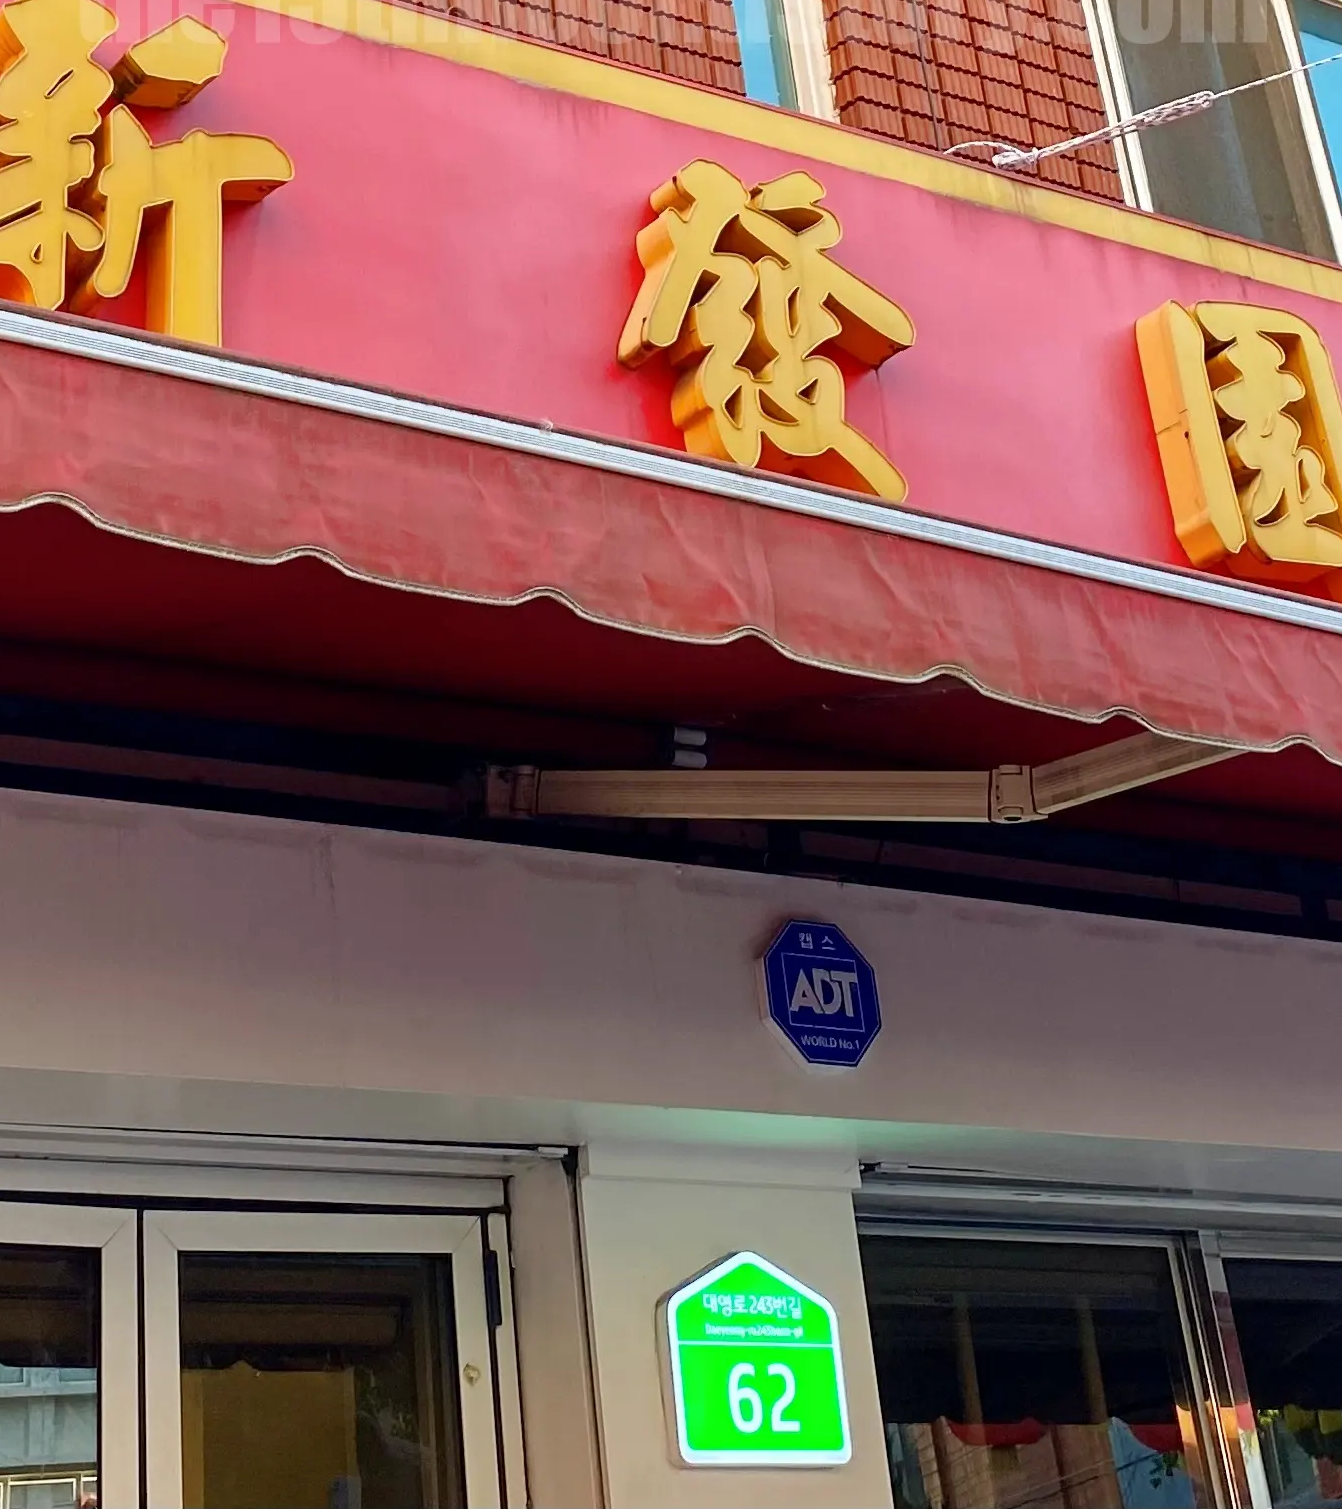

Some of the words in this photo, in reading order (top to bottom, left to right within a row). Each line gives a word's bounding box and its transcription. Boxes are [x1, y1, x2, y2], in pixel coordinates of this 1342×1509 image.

[789, 967, 858, 1018] ADT
[800, 1034, 837, 1049] WORLD
[727, 1362, 802, 1434] 62
